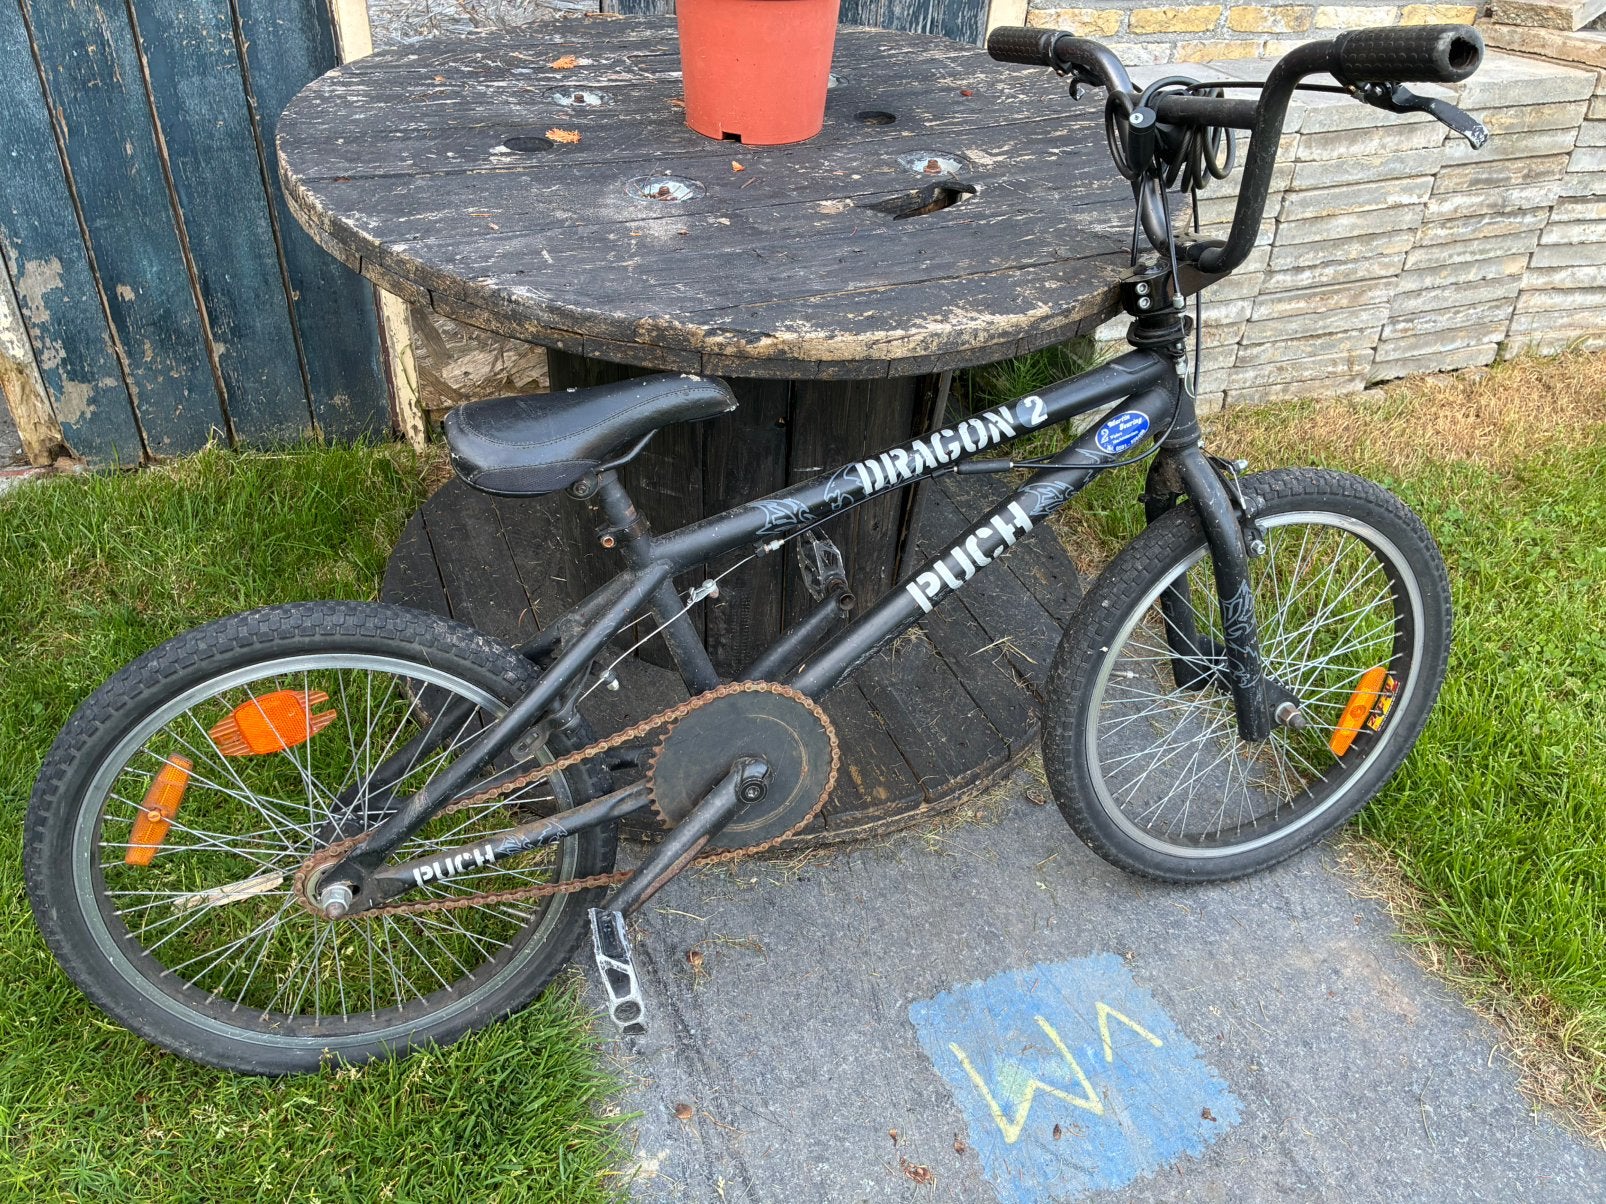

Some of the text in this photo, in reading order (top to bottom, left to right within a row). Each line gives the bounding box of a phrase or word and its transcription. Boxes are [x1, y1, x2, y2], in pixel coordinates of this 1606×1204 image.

[855, 395, 1049, 495] DRAGON 2
[906, 501, 1034, 614] PUCH
[412, 844, 496, 888] PUCH
